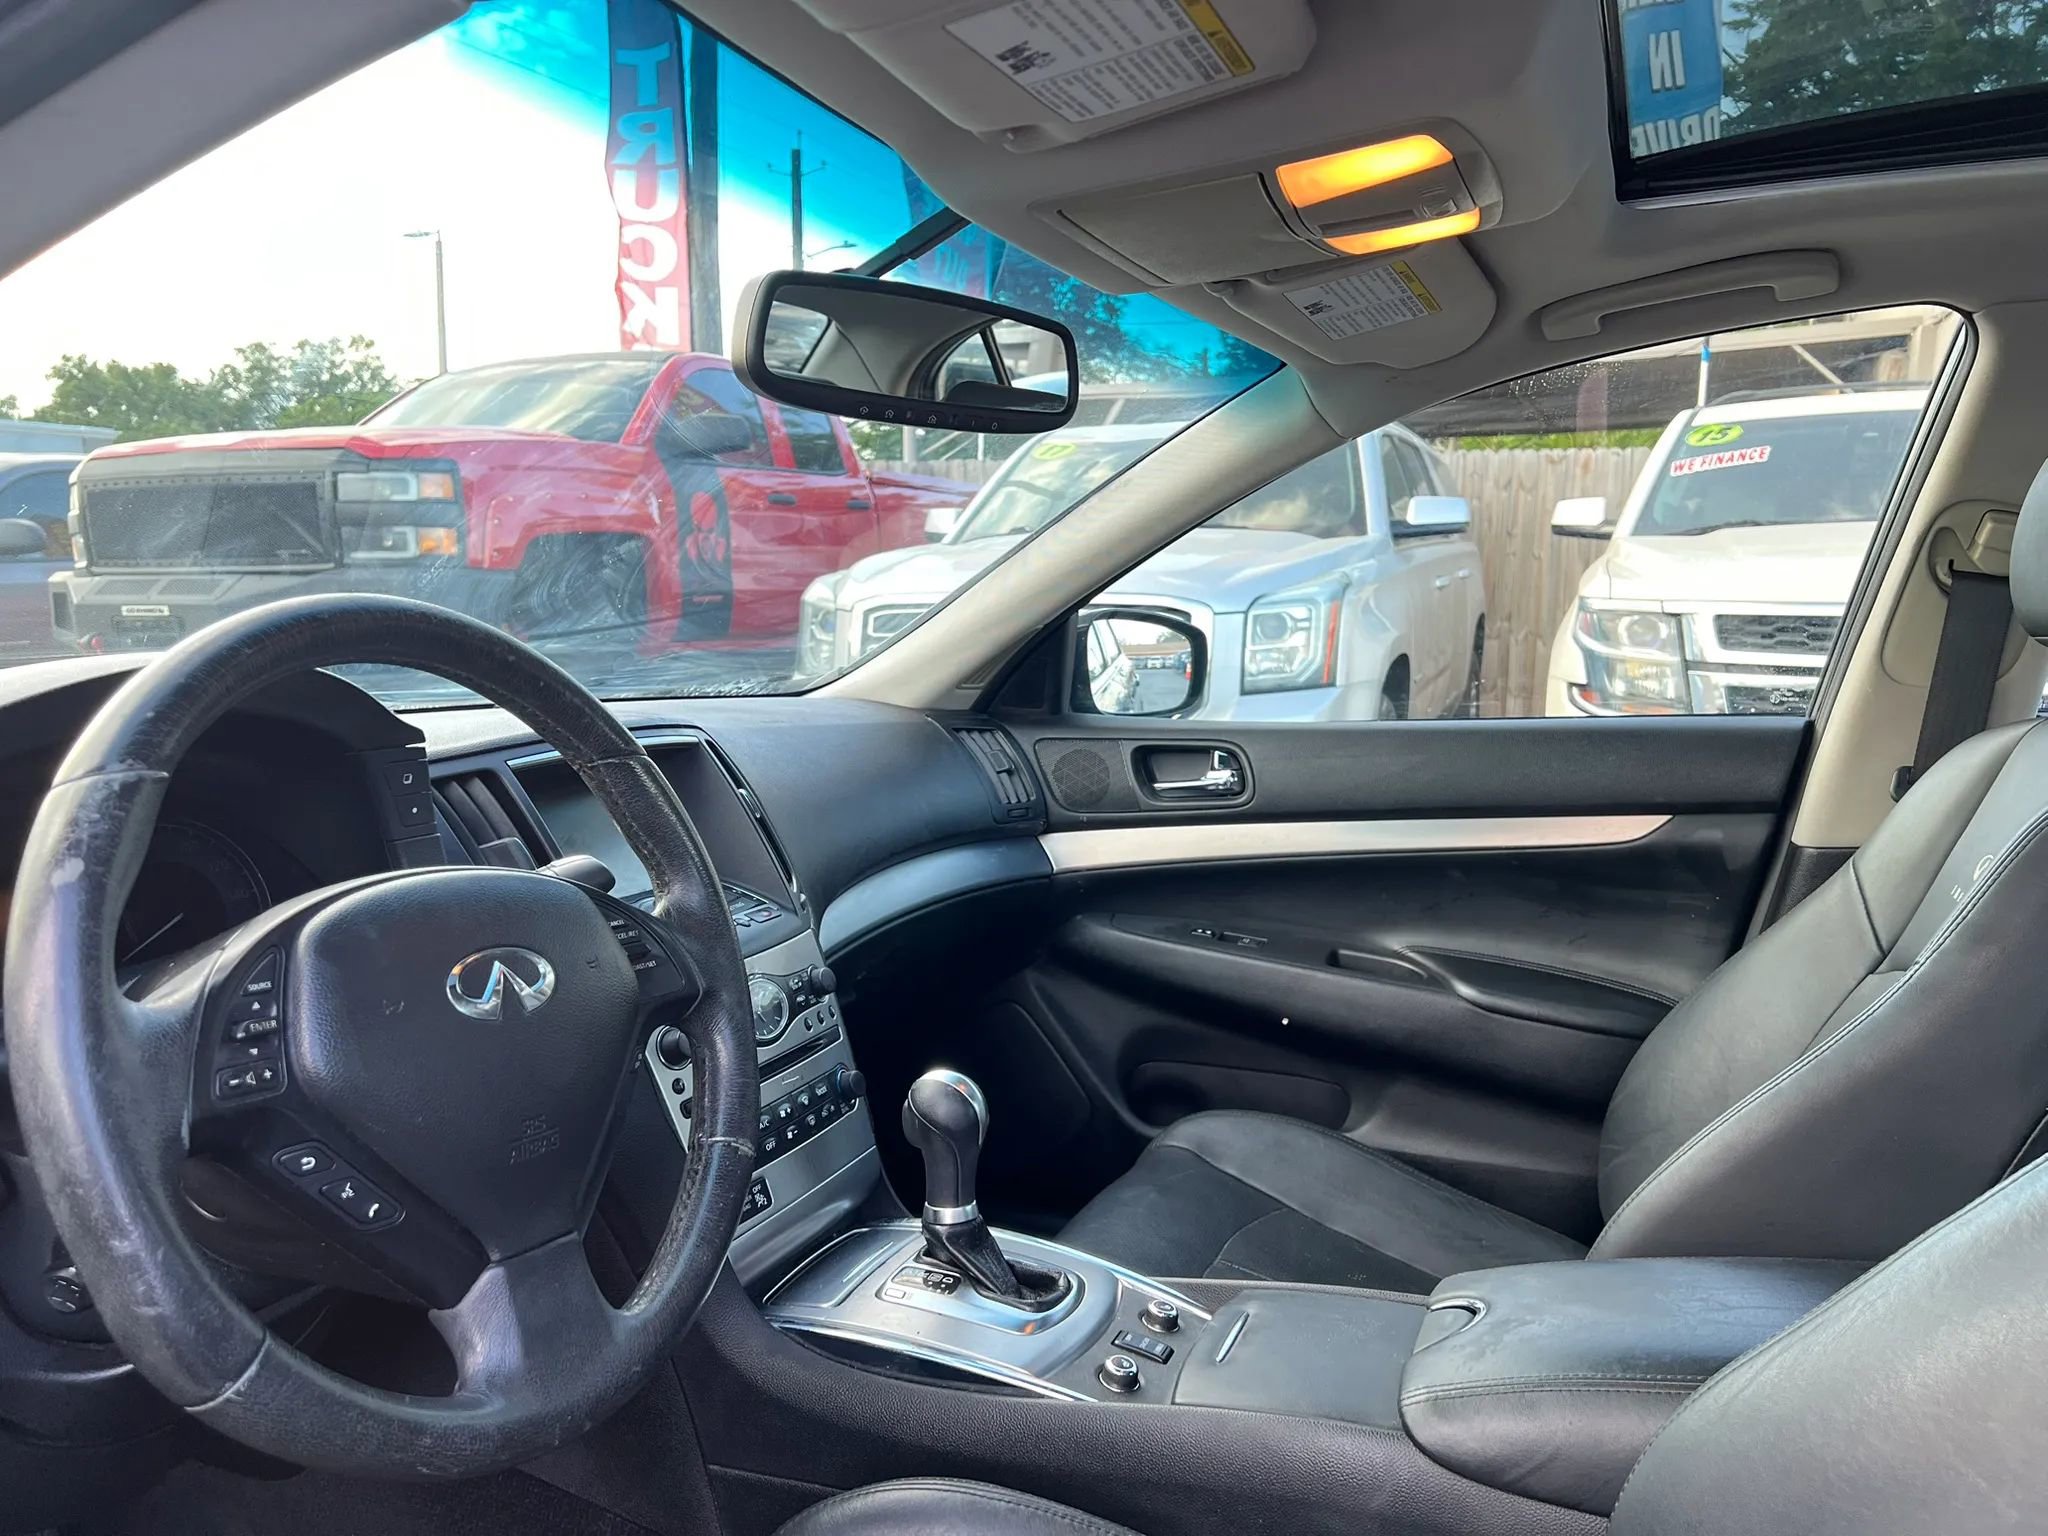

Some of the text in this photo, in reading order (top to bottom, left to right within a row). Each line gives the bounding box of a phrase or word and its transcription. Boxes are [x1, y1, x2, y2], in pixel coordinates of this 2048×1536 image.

[1673, 447, 1769, 473] WE FINANCE
[247, 980, 273, 992] SOURCE
[250, 1019, 278, 1032] ENTER
[765, 1140, 776, 1152] OFF
